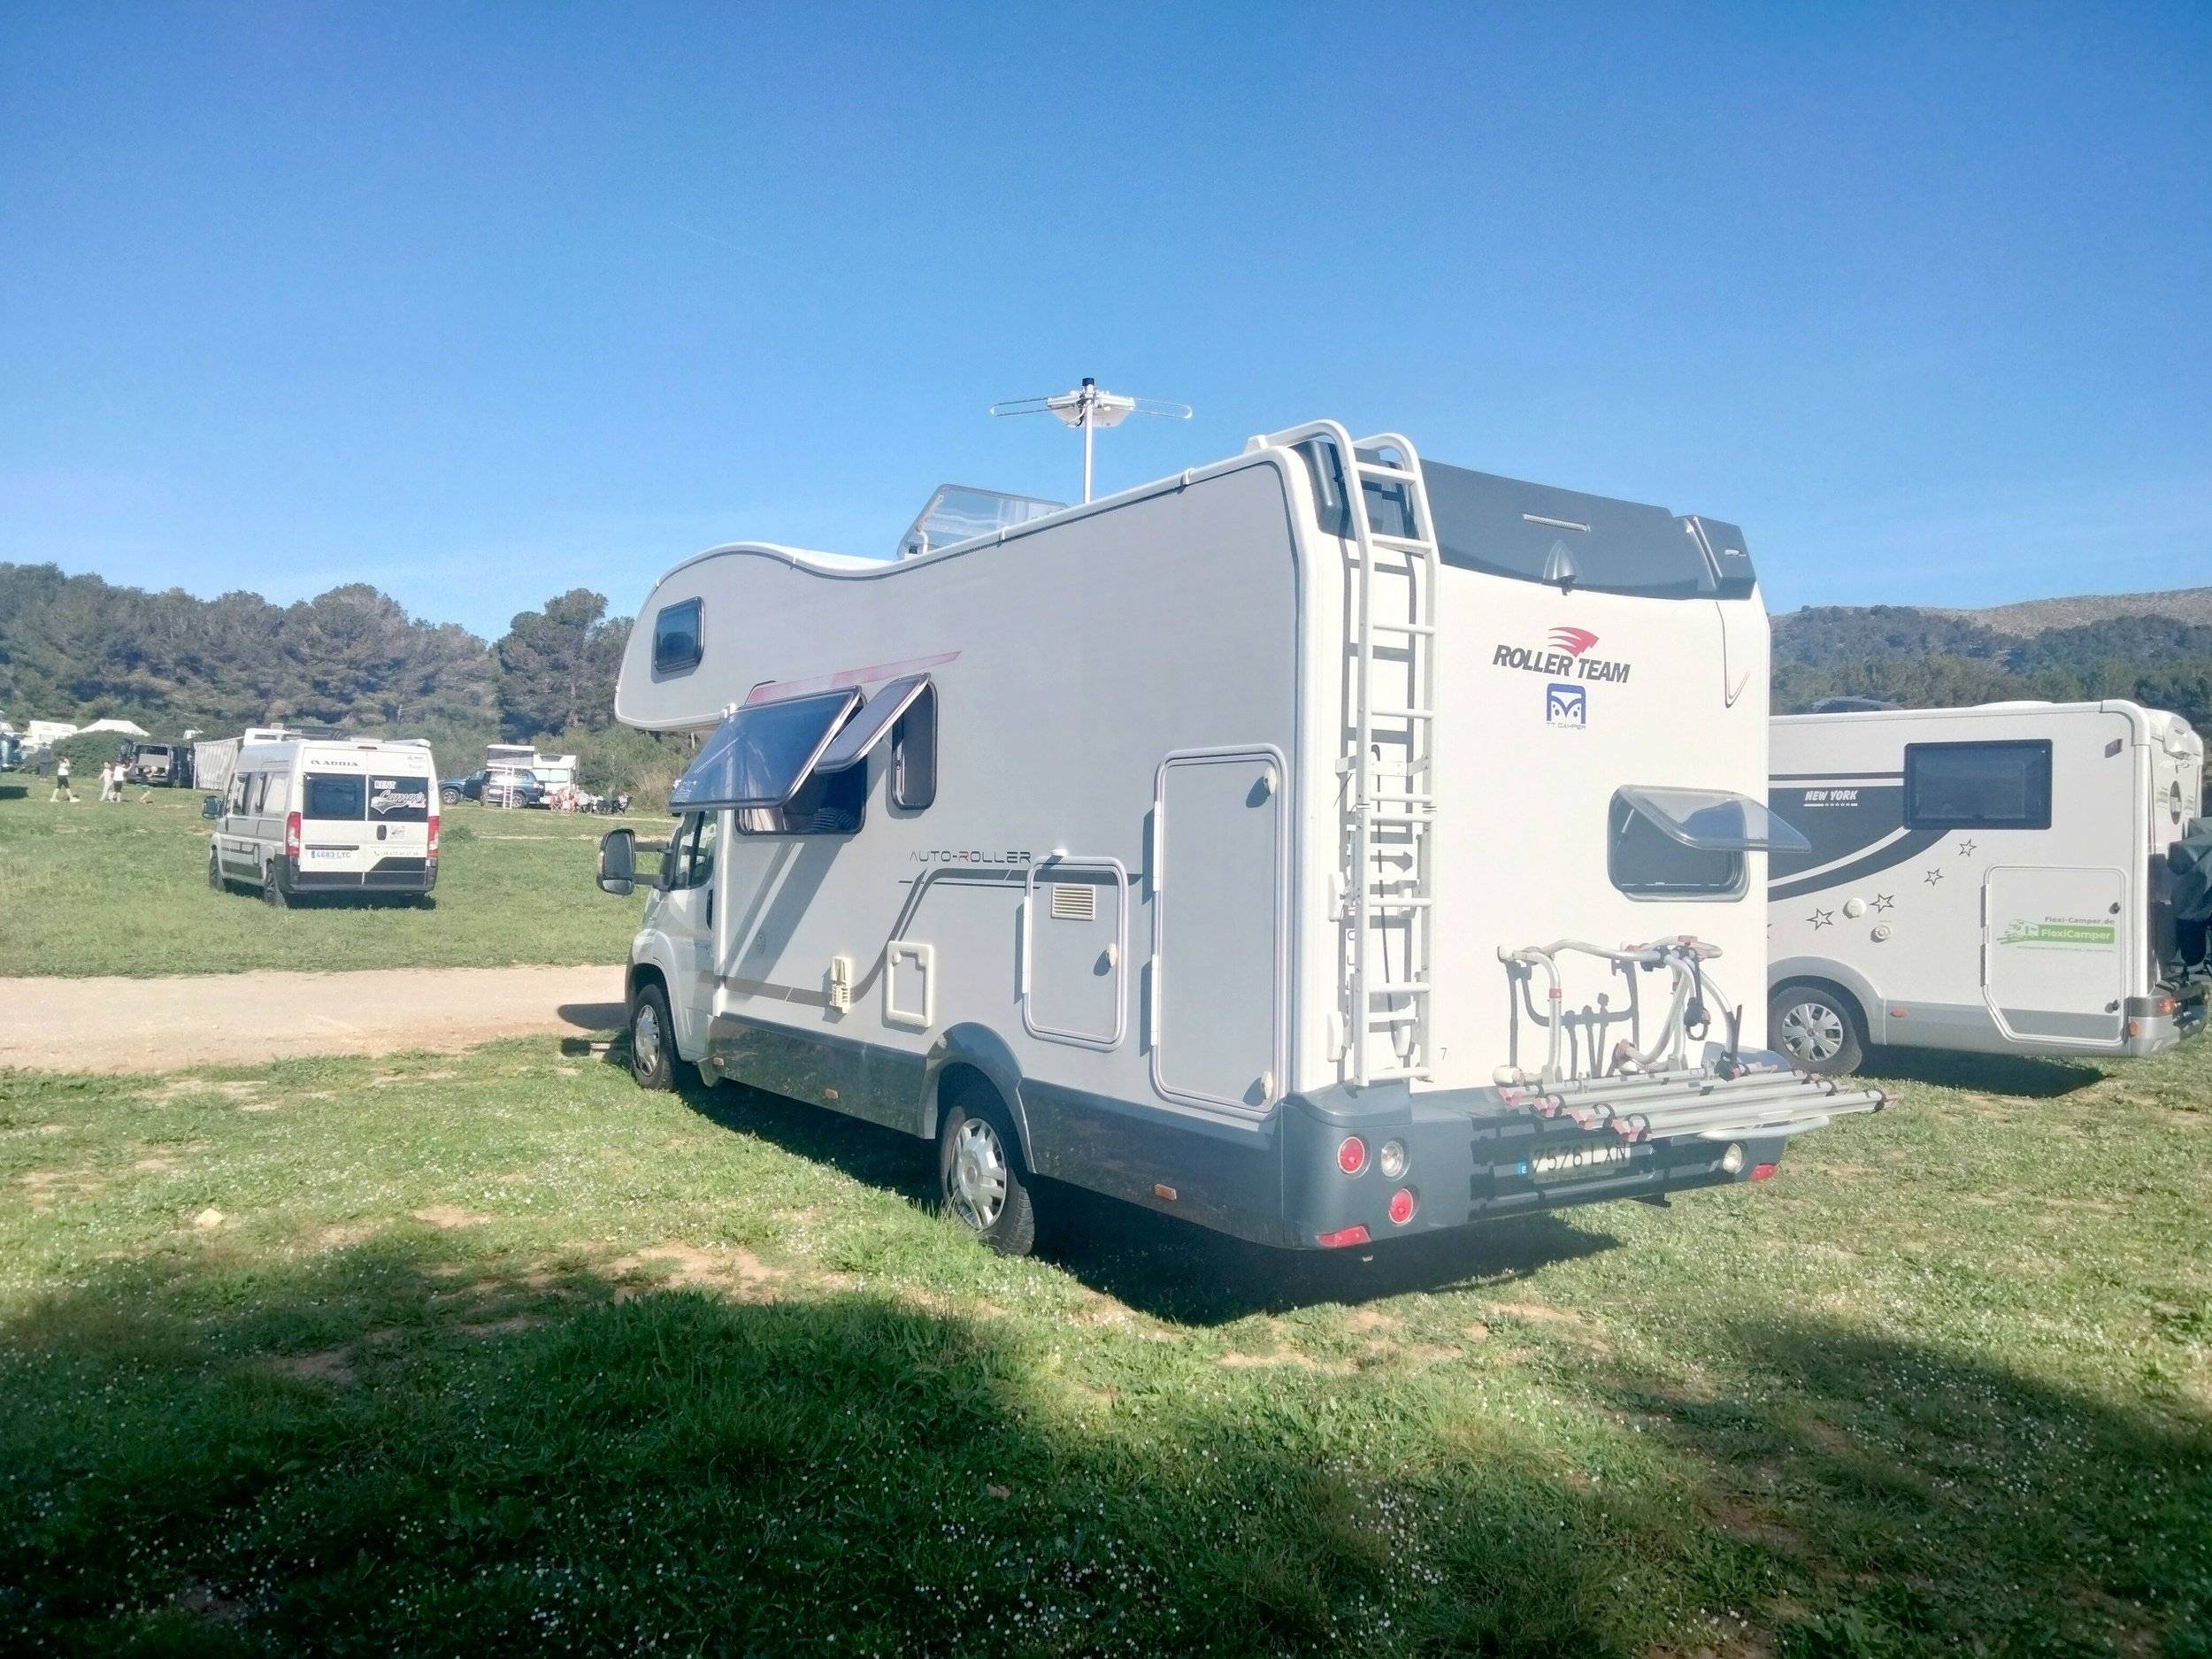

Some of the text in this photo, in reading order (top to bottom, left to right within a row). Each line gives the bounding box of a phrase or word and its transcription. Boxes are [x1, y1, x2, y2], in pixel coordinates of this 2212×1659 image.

[1492, 644, 1631, 684] ROLLER TEAM
[1805, 789, 1858, 801] NEW YORK
[909, 850, 1032, 864] AUTO-ROLLER
[2041, 929, 2111, 941] FlexiCamper
